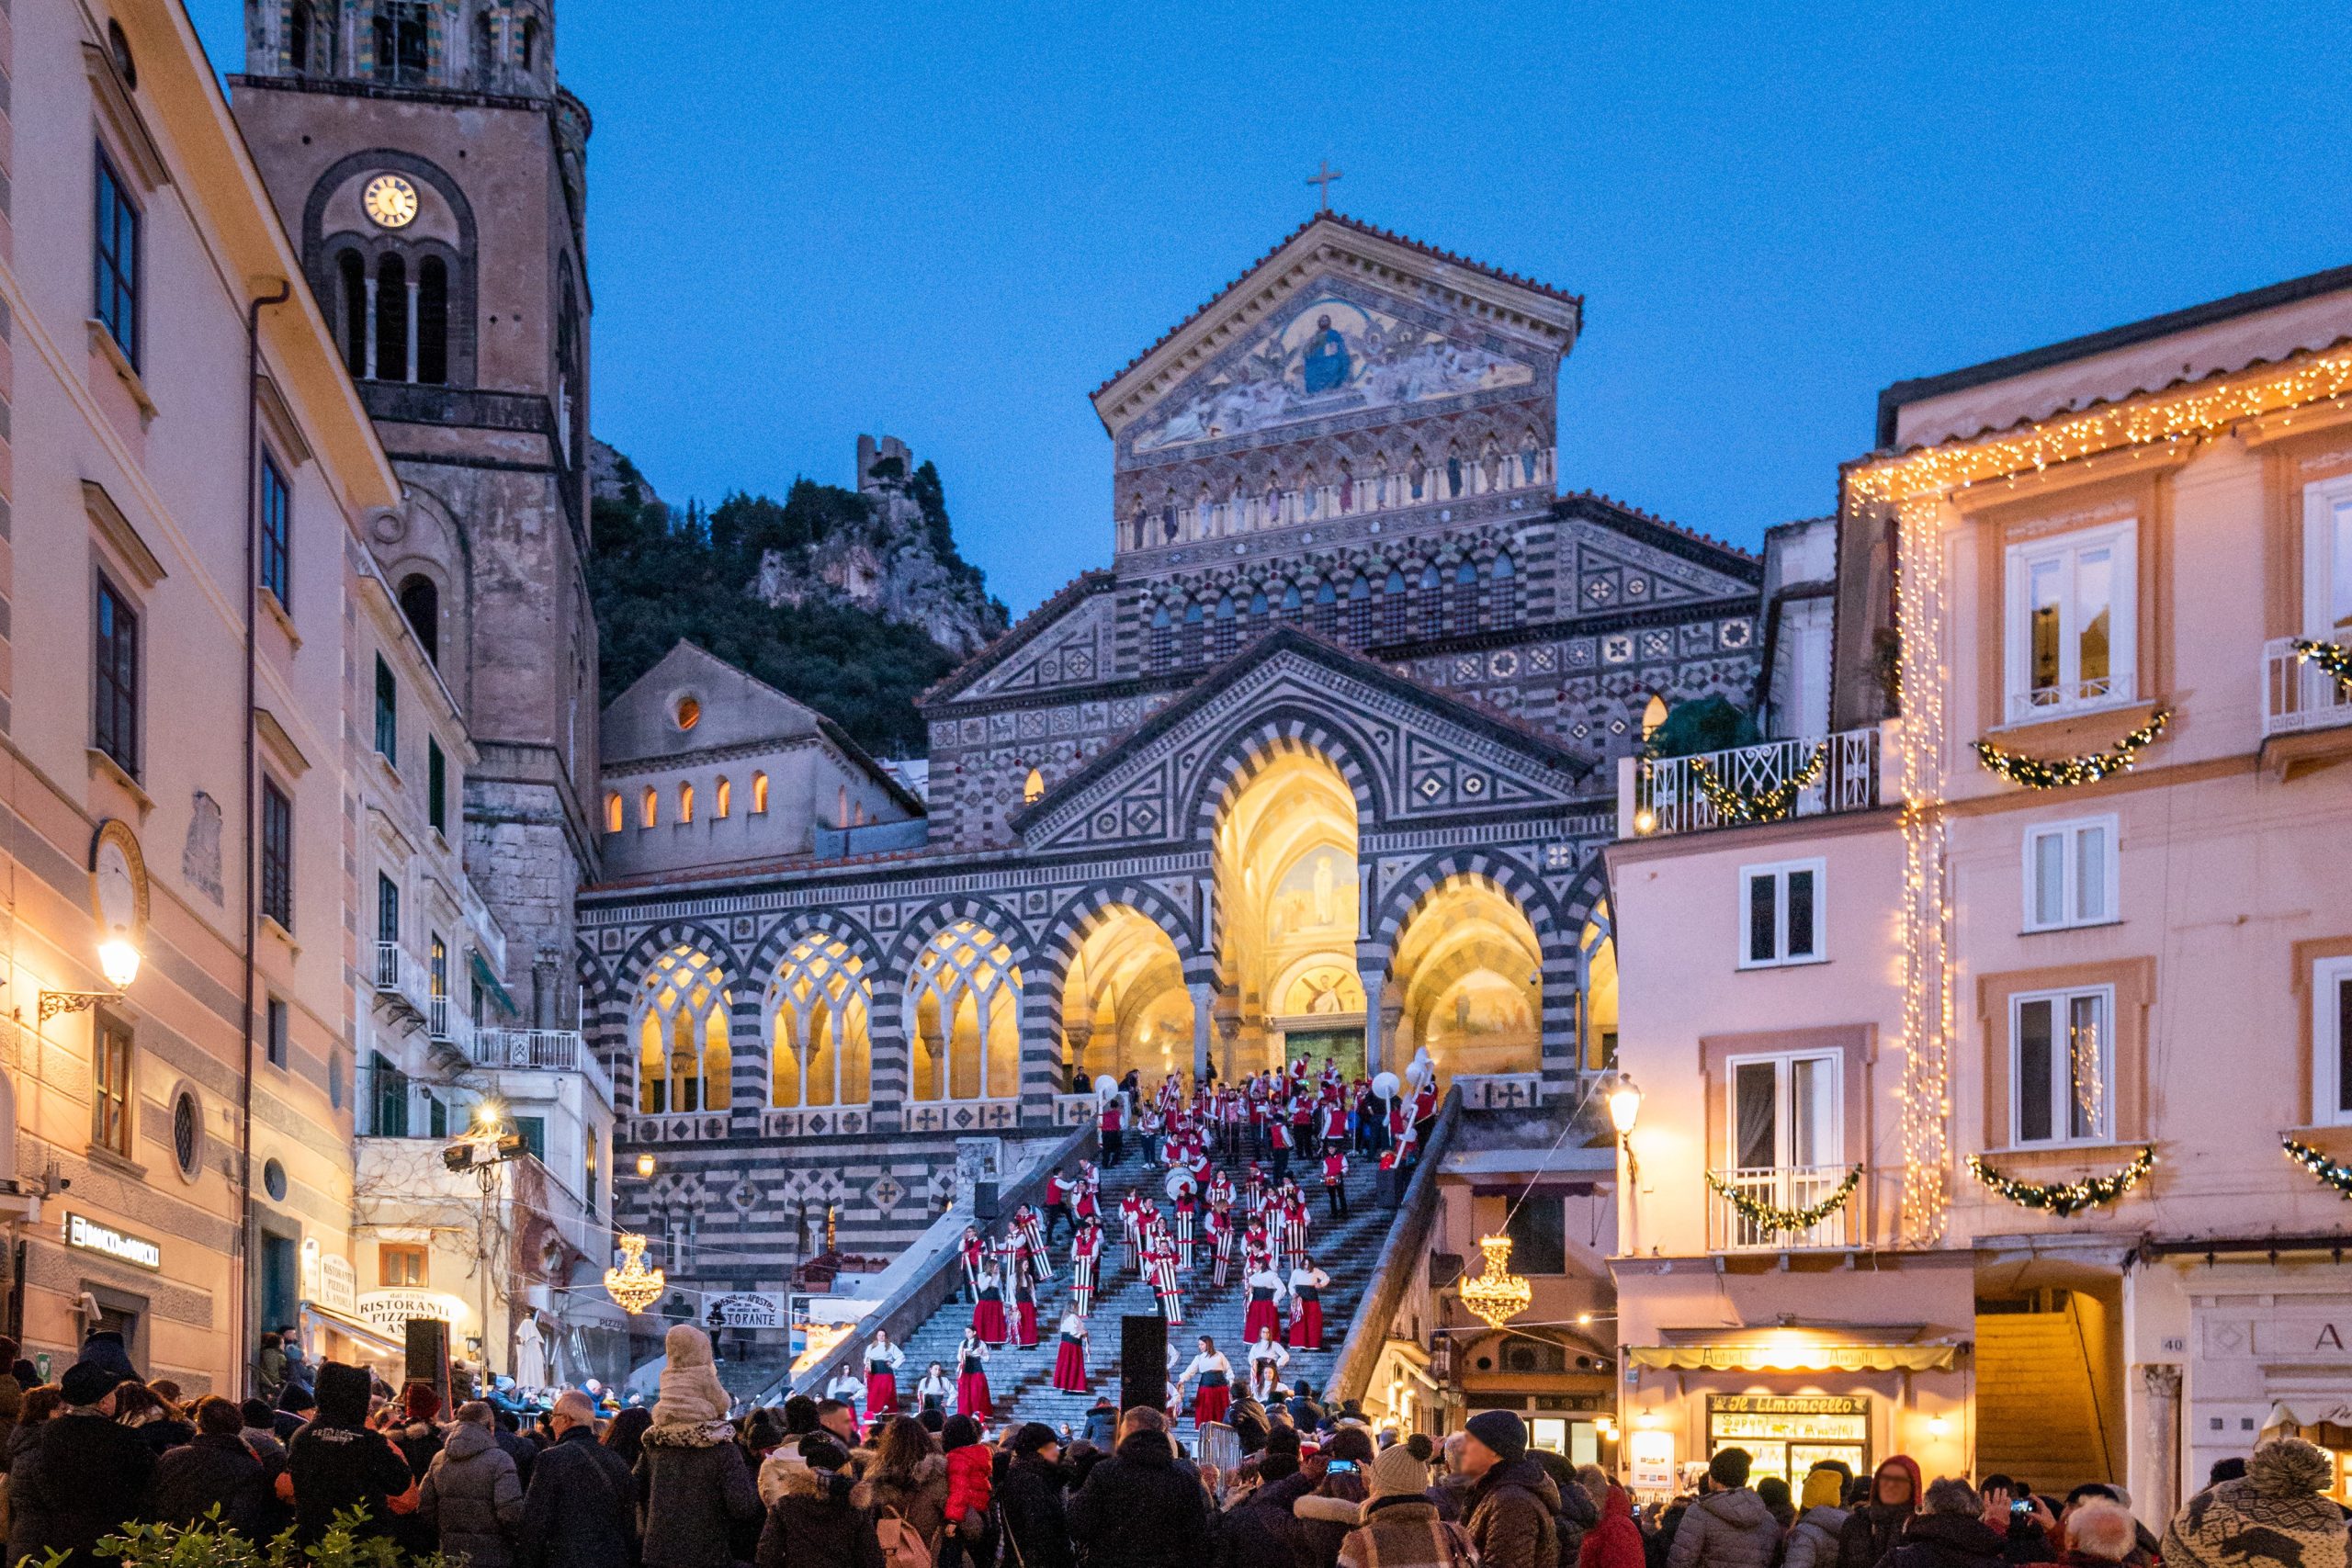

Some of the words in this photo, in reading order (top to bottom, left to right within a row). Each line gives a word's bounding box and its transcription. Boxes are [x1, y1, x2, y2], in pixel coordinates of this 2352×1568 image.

[323, 1263, 354, 1284] RISTORANTE
[2165, 1339, 2183, 1350] 40
[1728, 1397, 1748, 1412] Il
[1723, 1415, 1770, 1428] Sapori
